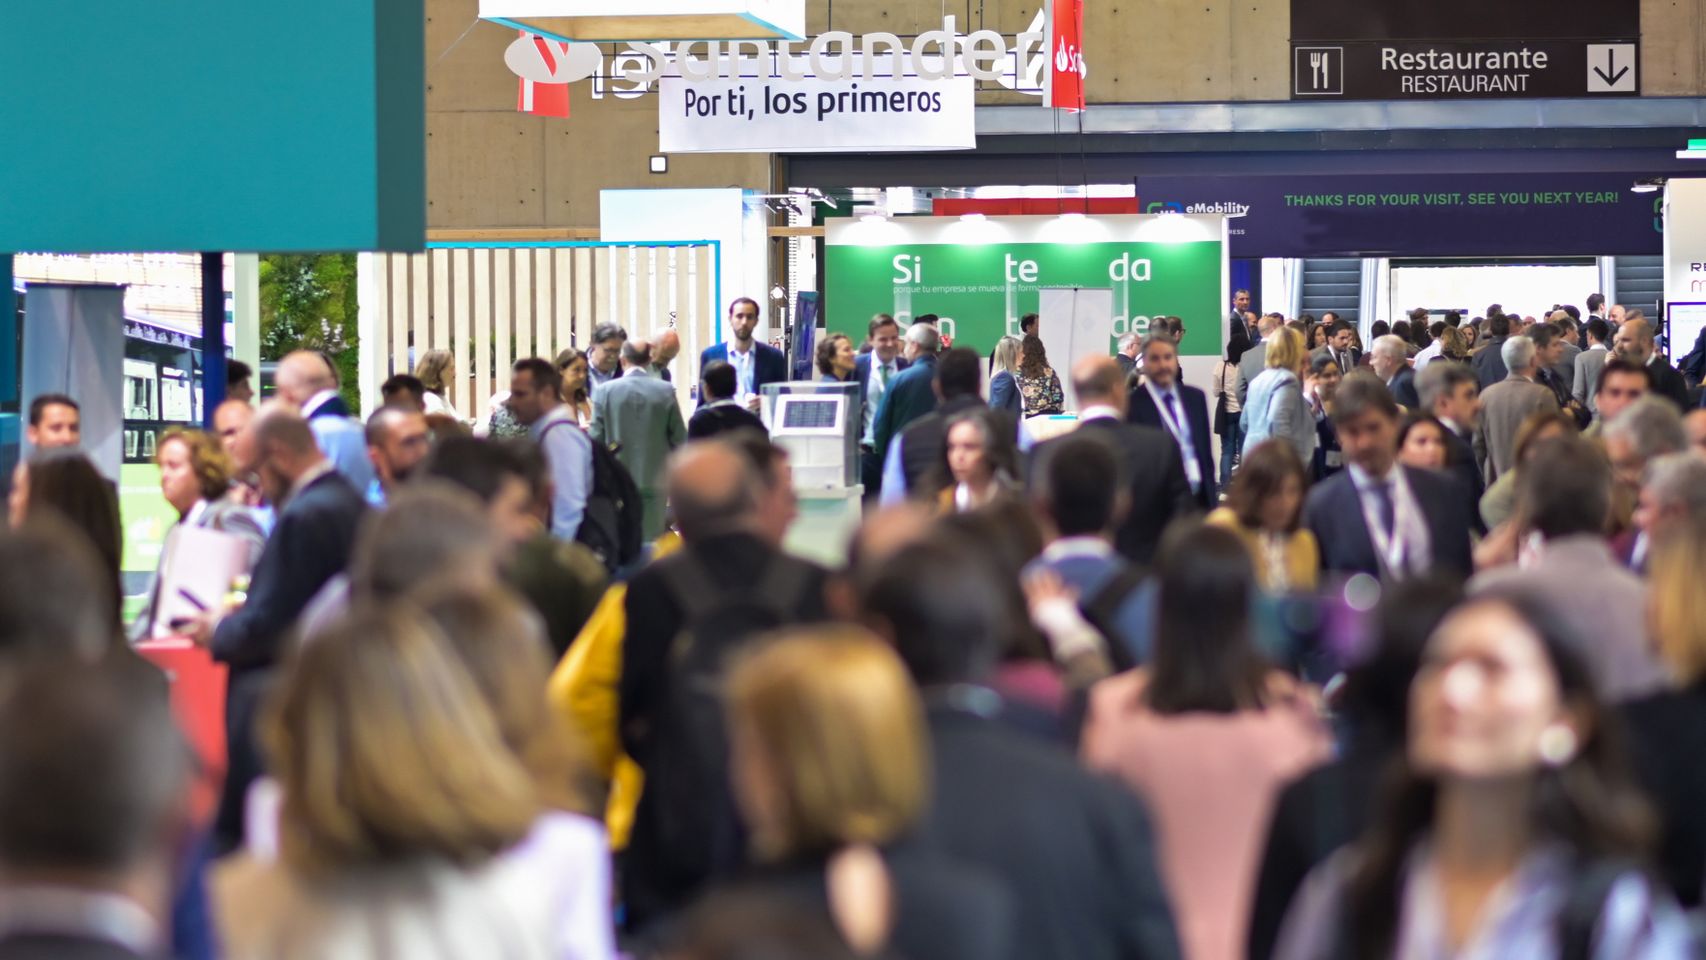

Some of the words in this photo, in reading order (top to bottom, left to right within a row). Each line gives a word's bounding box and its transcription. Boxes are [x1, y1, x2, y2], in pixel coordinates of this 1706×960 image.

[625, 15, 1043, 83] Santander
[1381, 48, 1548, 70] Restaurante
[1402, 74, 1529, 93] RESTAURANT
[685, 88, 721, 117] Por
[728, 86, 754, 120] ti,
[765, 83, 807, 115] los
[817, 83, 941, 121] primeros
[1186, 202, 1250, 216] eMobility
[1284, 194, 1343, 207] THANKS
[1347, 194, 1376, 206] FOR
[1379, 193, 1420, 206] YOUR
[1468, 193, 1496, 205] SEE
[1499, 192, 1529, 205] YOU
[1533, 192, 1572, 204] NEXT
[1575, 191, 1619, 204] YEAR!
[892, 253, 922, 284] Si
[1005, 253, 1038, 283] te
[1108, 252, 1151, 281] da
[932, 286, 967, 294] empresa
[1110, 307, 1167, 338] de
